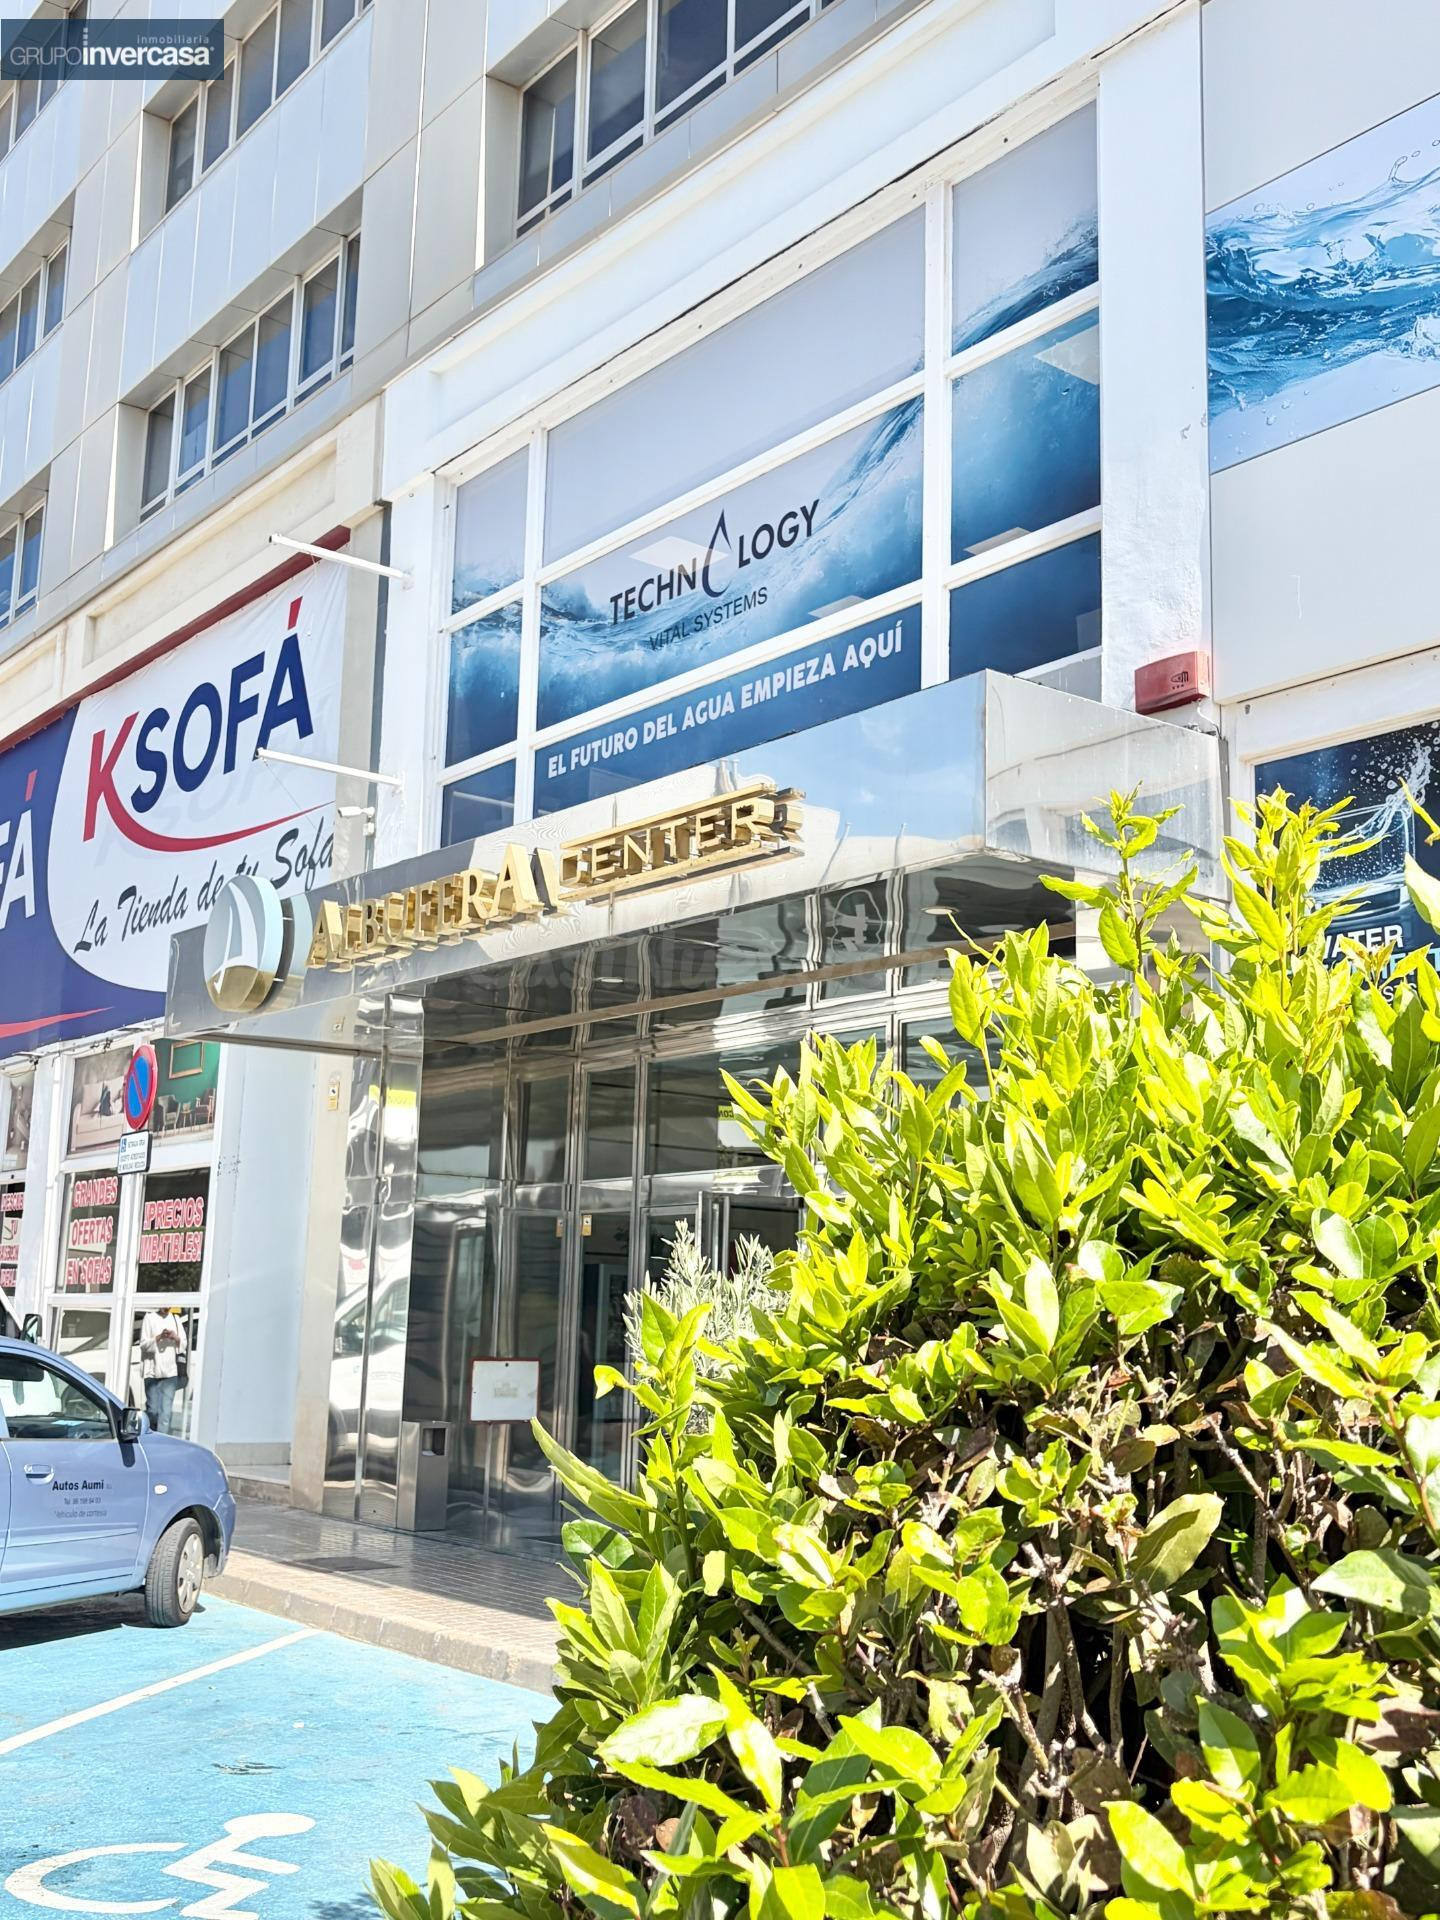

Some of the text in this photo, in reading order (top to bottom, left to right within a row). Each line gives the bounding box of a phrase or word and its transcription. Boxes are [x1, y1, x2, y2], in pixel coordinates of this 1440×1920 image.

[649, 586, 769, 651] VITAL SYSTEMS
[83, 596, 315, 846] KSOFÁ
[547, 620, 903, 779] EL FUTURO DEL AGUA EMPIEZA AQUÍ
[73, 898, 108, 954] La
[117, 874, 189, 942] Tienda
[197, 859, 224, 912] de
[305, 796, 776, 967] ALBUFERA CENTER
[73, 1176, 118, 1208] GRANDES
[71, 1216, 113, 1246] OFERTAS
[66, 1258, 80, 1285] EN
[52, 1480, 79, 1491] Autos
